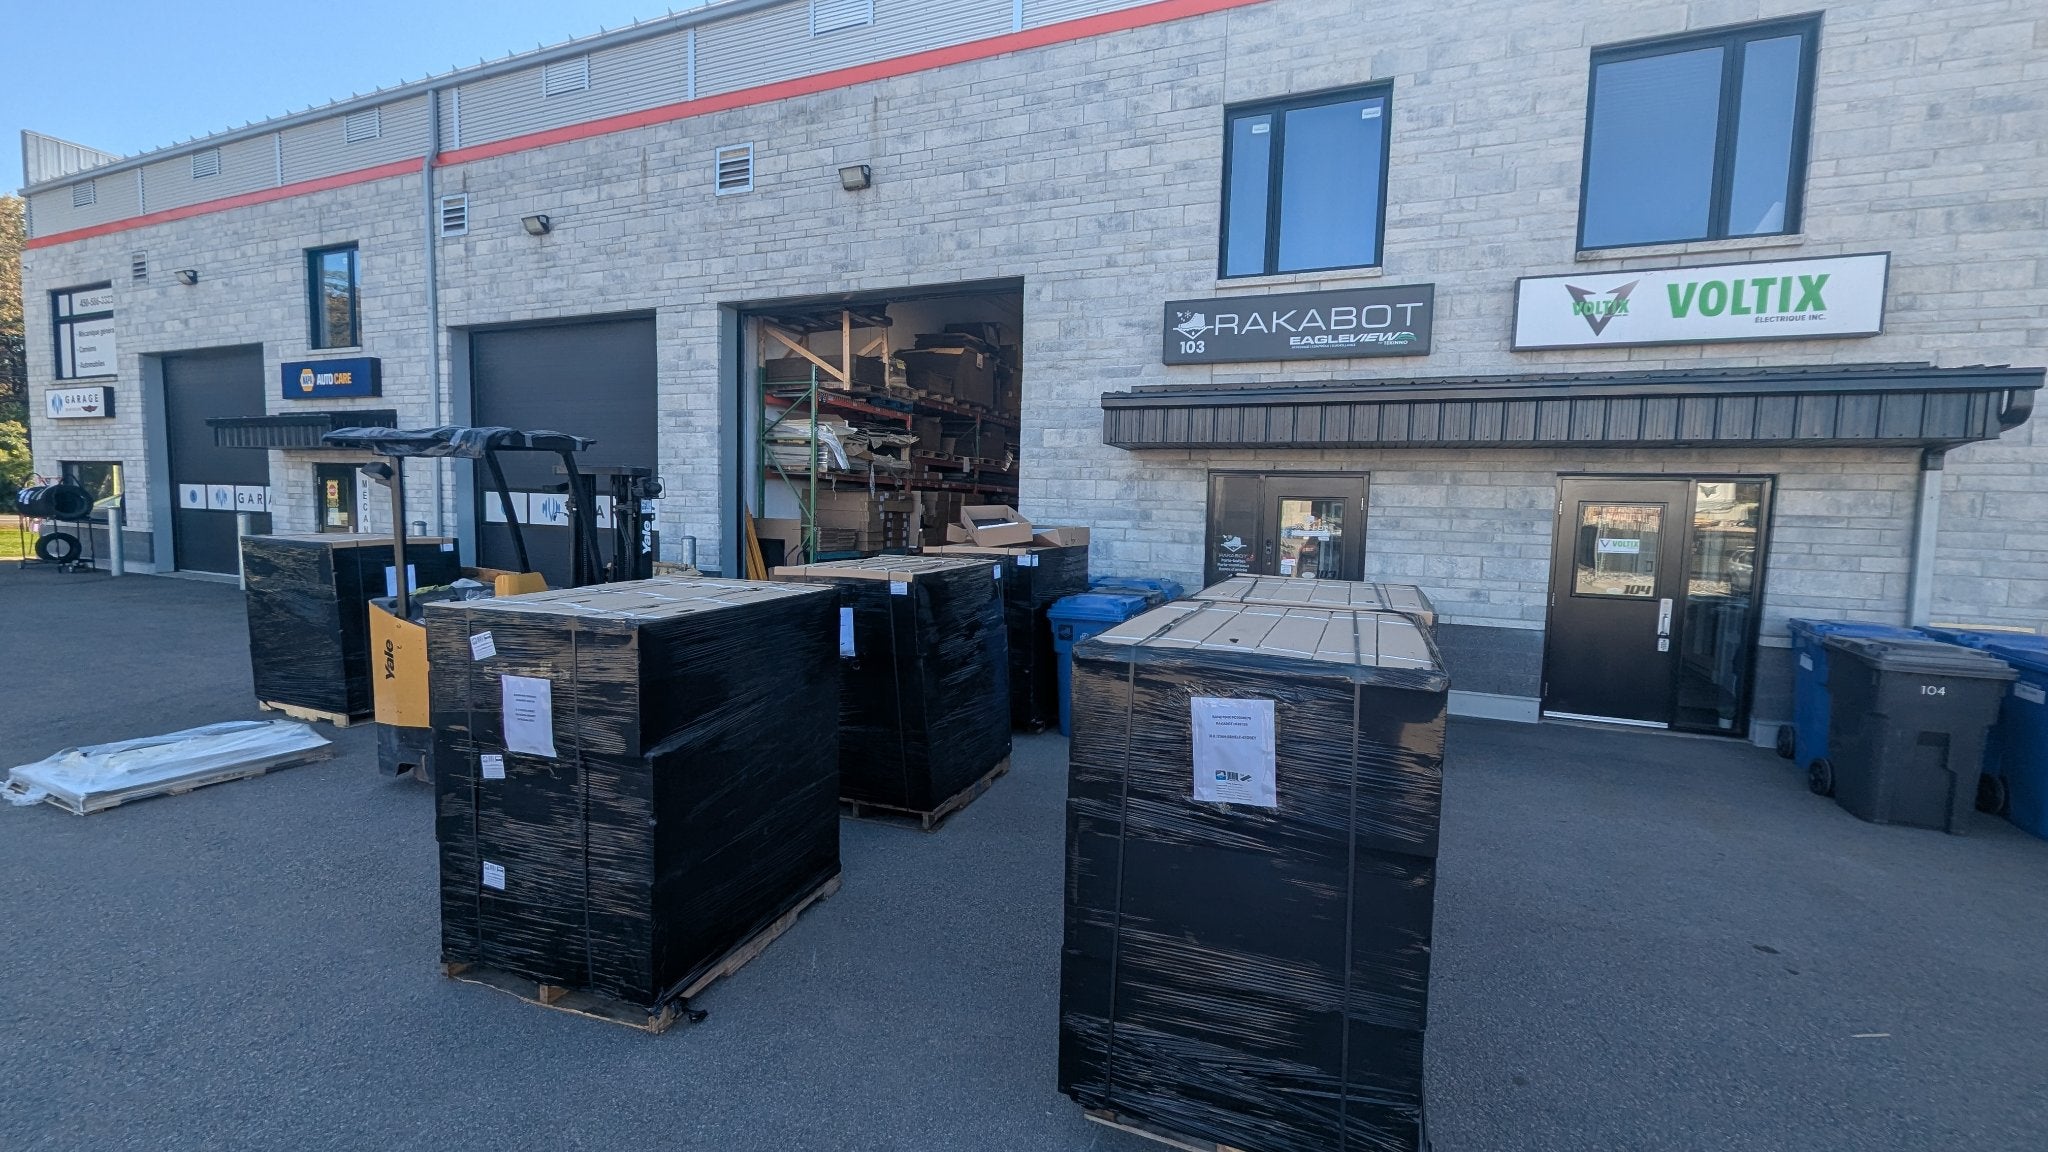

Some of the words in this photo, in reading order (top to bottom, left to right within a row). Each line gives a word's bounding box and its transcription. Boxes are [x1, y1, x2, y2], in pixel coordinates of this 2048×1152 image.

[1667, 273, 1832, 319] VOLTIX
[1572, 298, 1630, 317] VOLTIX
[1214, 302, 1424, 336] RAKABOT
[1755, 313, 1806, 324] ÉLECTRIQUE
[1808, 313, 1827, 321] INC.
[1289, 331, 1401, 346] EAGLEVIEW
[1179, 340, 1205, 354] 103
[316, 373, 333, 385] AUTO
[333, 372, 352, 385] CARE
[65, 393, 99, 404] GARAGE
[641, 520, 652, 554] Yale
[1624, 584, 1651, 595] 104
[384, 639, 395, 680] Yale
[1921, 685, 1946, 696] 104
